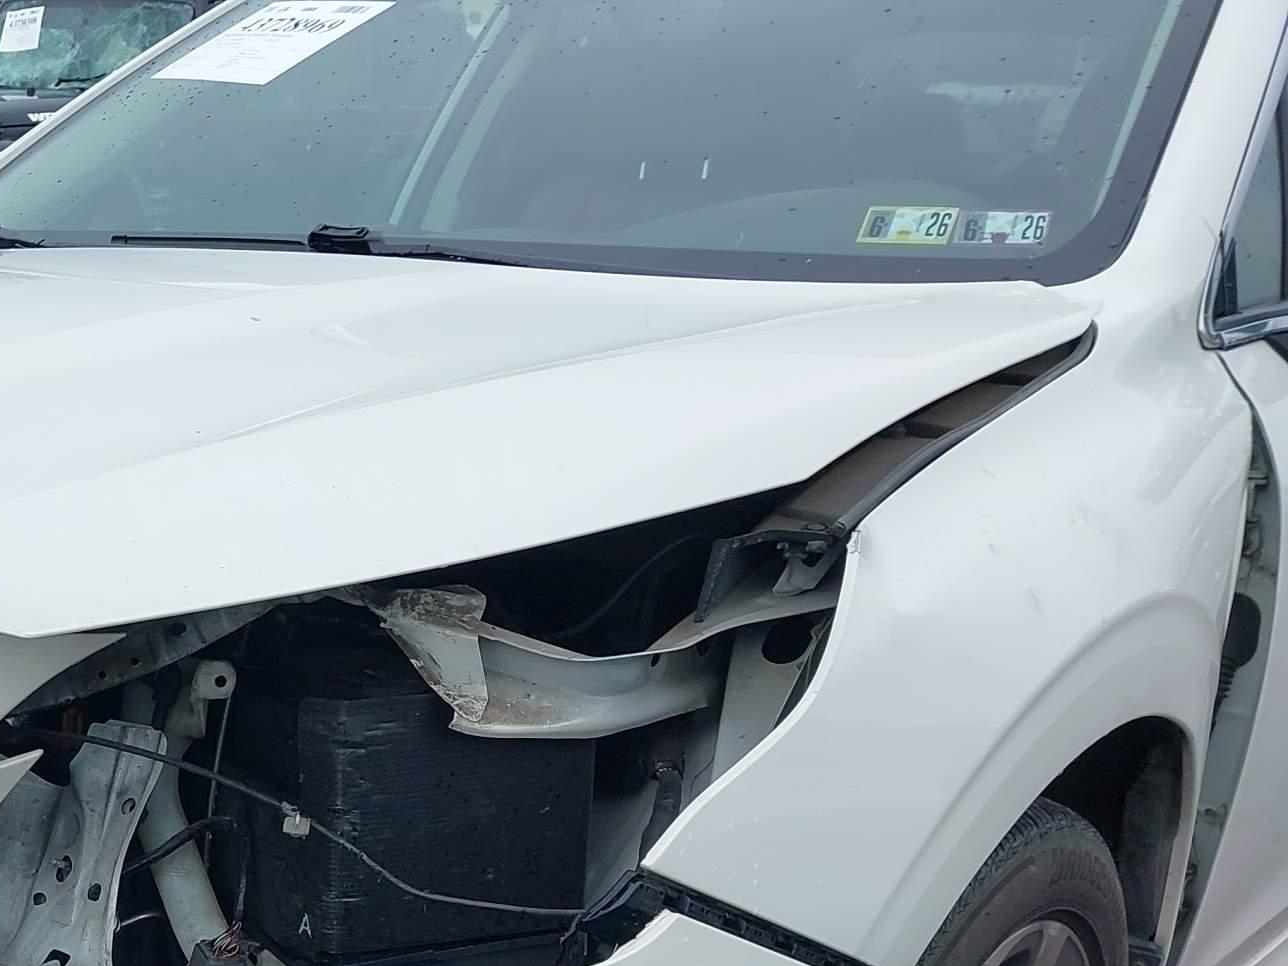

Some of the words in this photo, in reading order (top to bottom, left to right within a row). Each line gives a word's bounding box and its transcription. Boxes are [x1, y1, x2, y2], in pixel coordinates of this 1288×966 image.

[241, 17, 346, 34] 43728969
[924, 212, 953, 238] 26
[1020, 215, 1047, 241] 26
[298, 912, 312, 938] A
